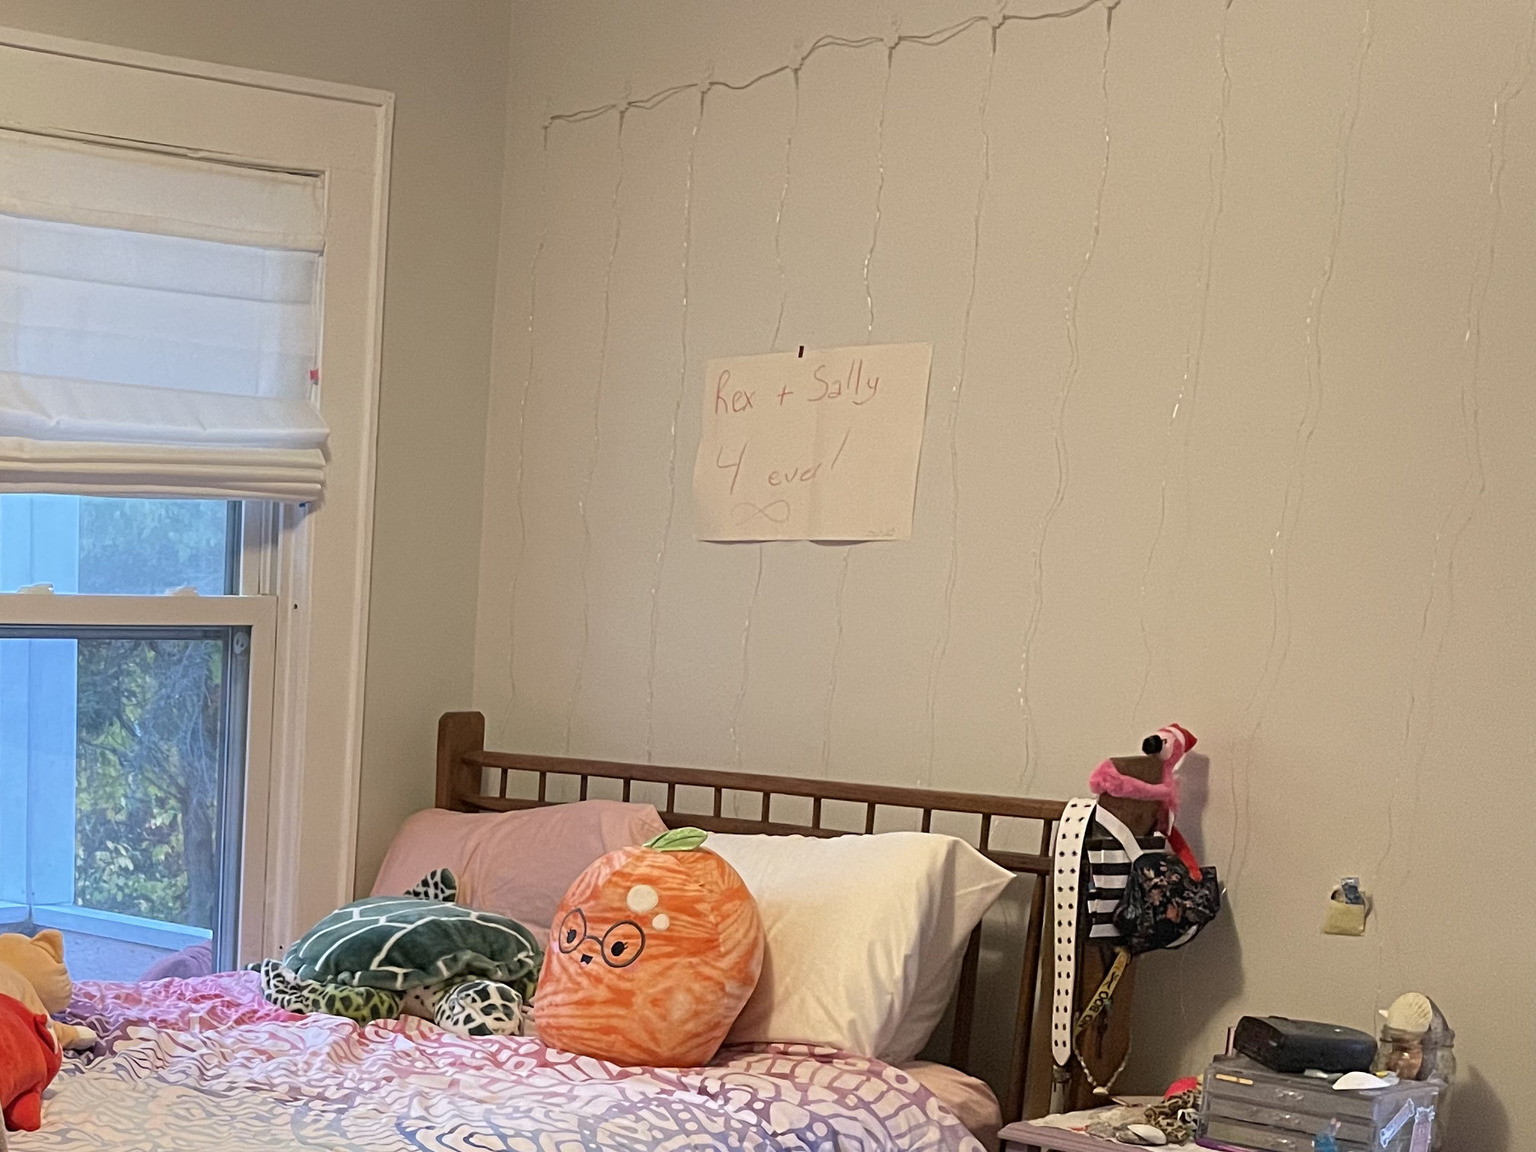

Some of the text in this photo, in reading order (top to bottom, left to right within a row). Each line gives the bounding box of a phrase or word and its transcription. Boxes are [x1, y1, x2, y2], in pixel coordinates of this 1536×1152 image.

[715, 359, 880, 416] Rex + Sally
[716, 439, 750, 496] 4
[1089, 990, 1109, 1013] BOO
